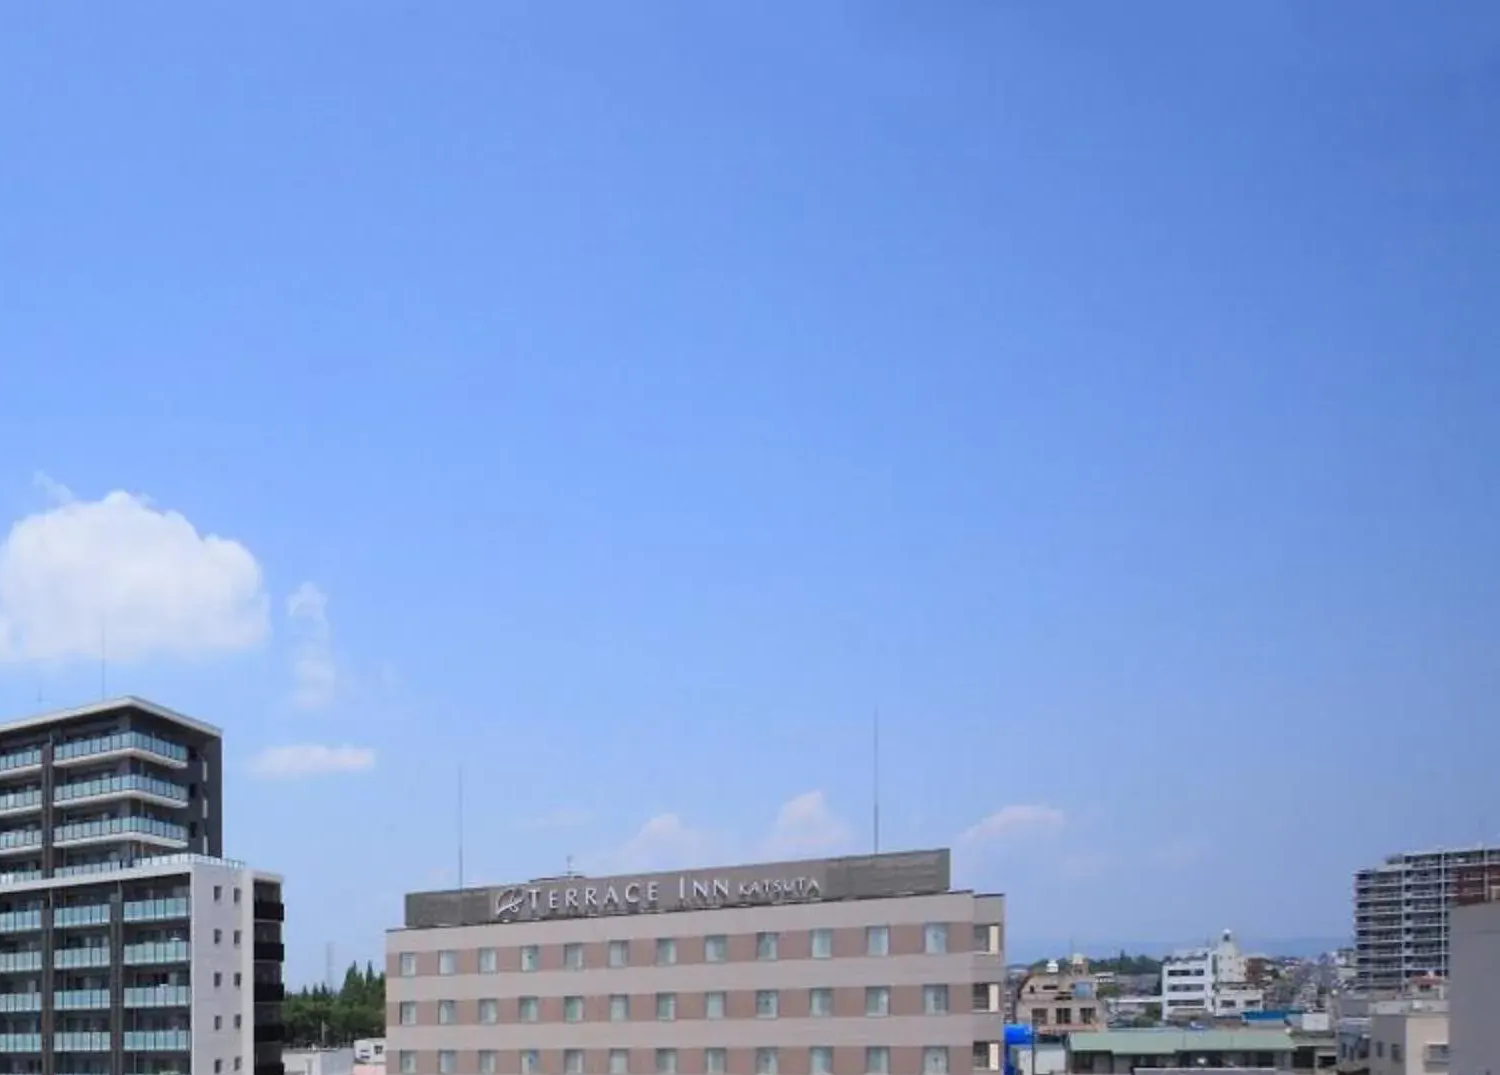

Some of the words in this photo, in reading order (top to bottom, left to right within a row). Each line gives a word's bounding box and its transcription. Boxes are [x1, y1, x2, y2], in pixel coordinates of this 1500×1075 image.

[527, 881, 660, 910] TERRACE
[678, 875, 731, 900] INN
[737, 877, 821, 897] KATSUTA
